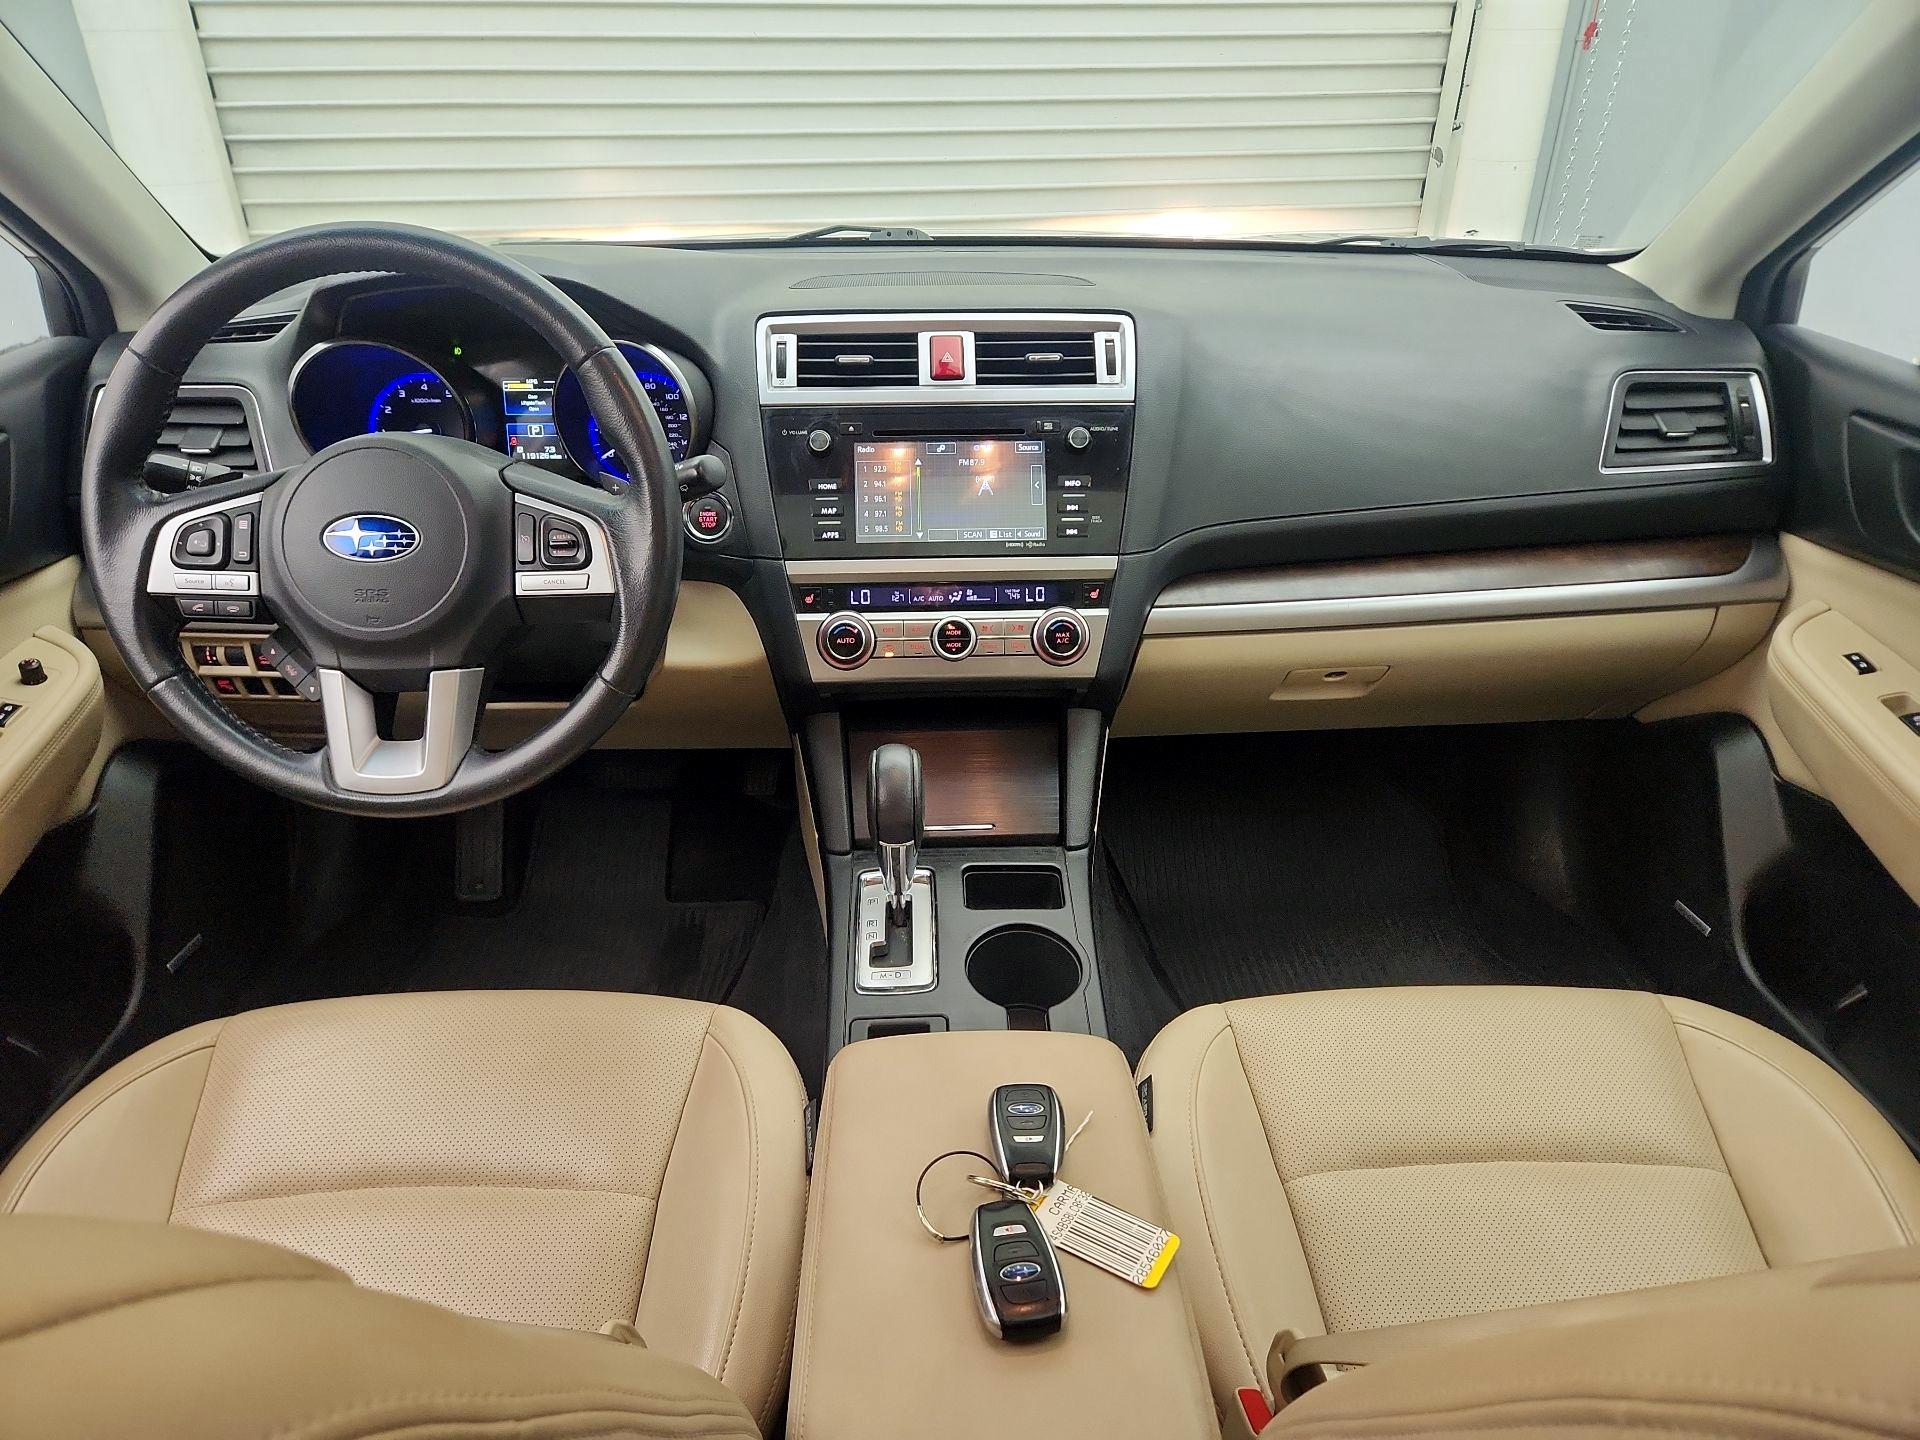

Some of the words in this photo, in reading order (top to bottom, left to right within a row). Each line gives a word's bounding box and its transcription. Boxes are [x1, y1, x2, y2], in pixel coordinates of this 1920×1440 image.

[421, 383, 428, 391] 4
[399, 390, 406, 398] 3
[385, 406, 392, 414] 2
[531, 426, 540, 436] P
[851, 589, 870, 604] LO
[1026, 587, 1044, 602] LO
[1132, 1228, 1170, 1286] 28546027
